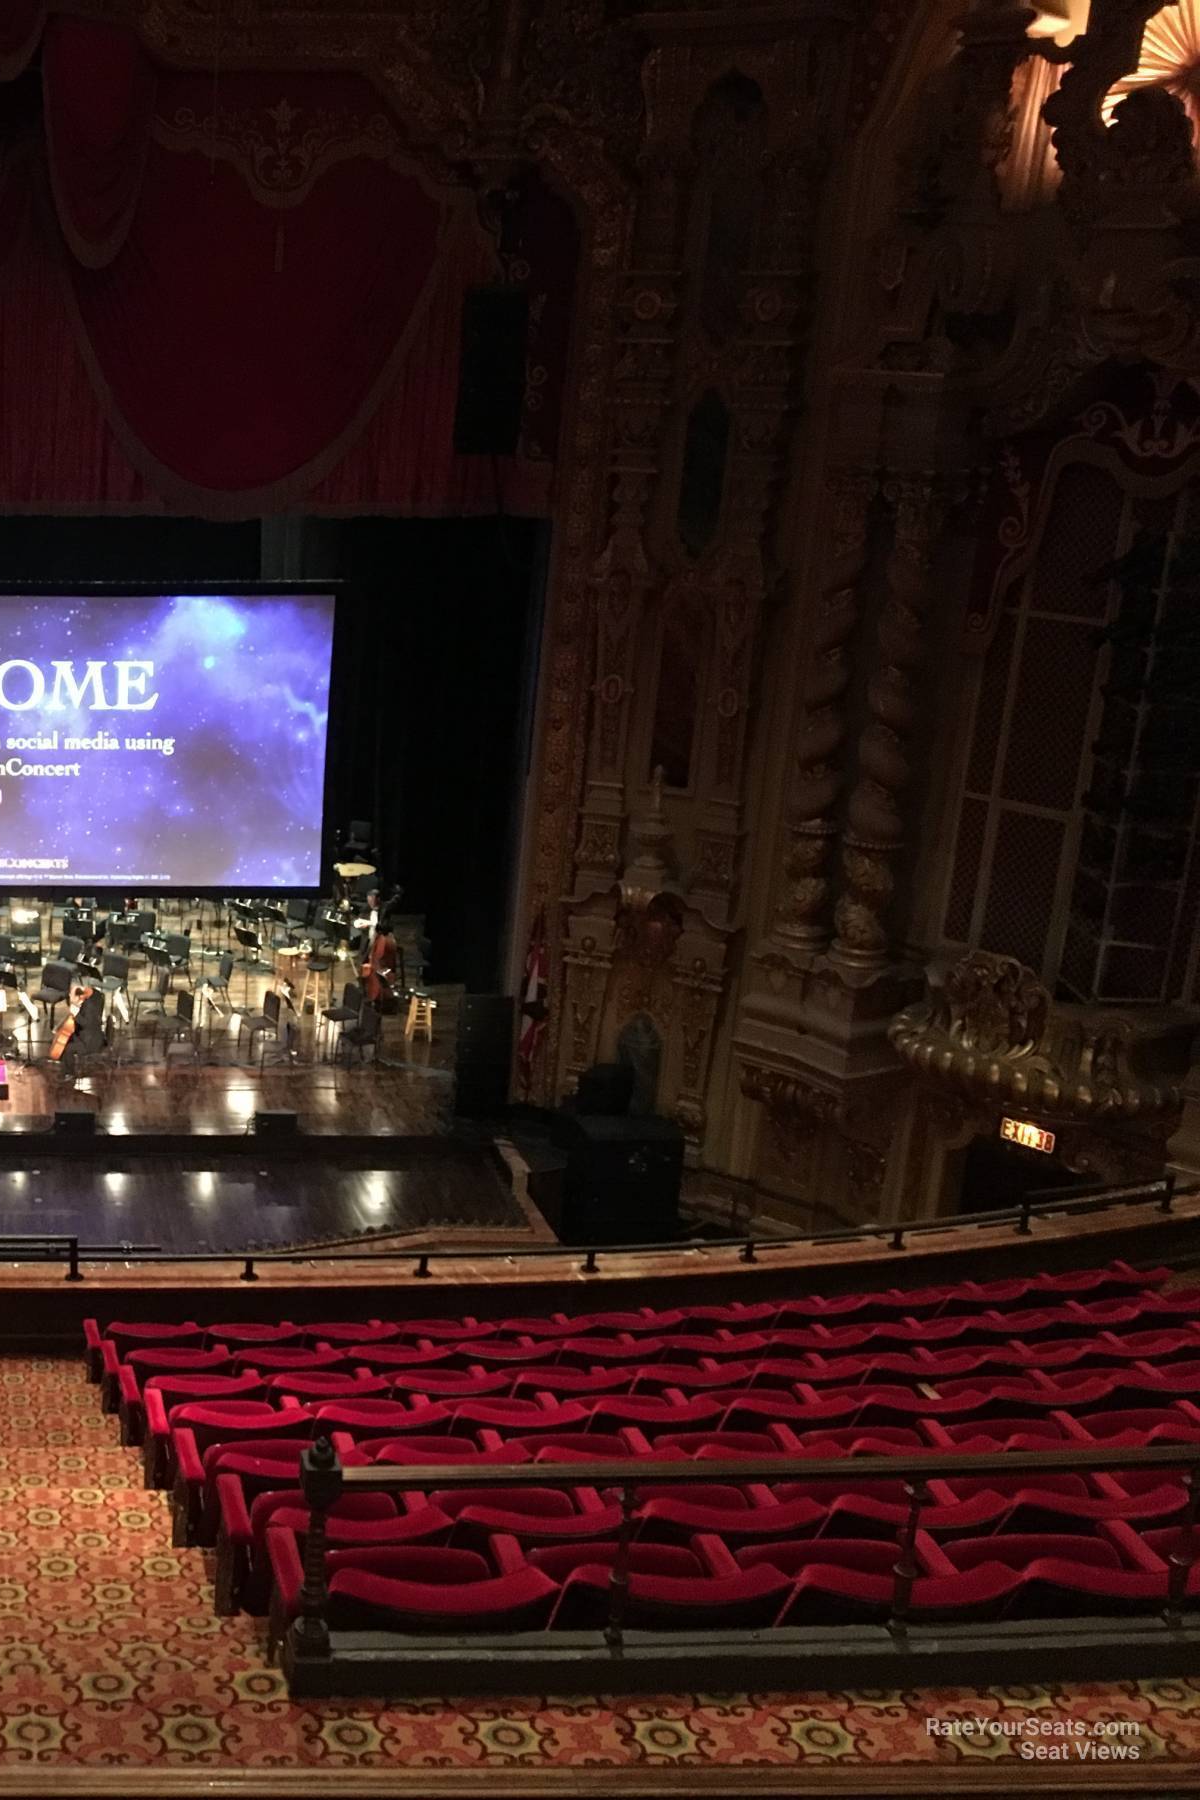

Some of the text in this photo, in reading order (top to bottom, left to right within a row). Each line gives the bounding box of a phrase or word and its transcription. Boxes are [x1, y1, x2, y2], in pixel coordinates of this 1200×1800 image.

[6, 730, 59, 751] social
[64, 730, 120, 751] media
[125, 731, 176, 756] using
[1002, 1119, 1034, 1146] EXIT
